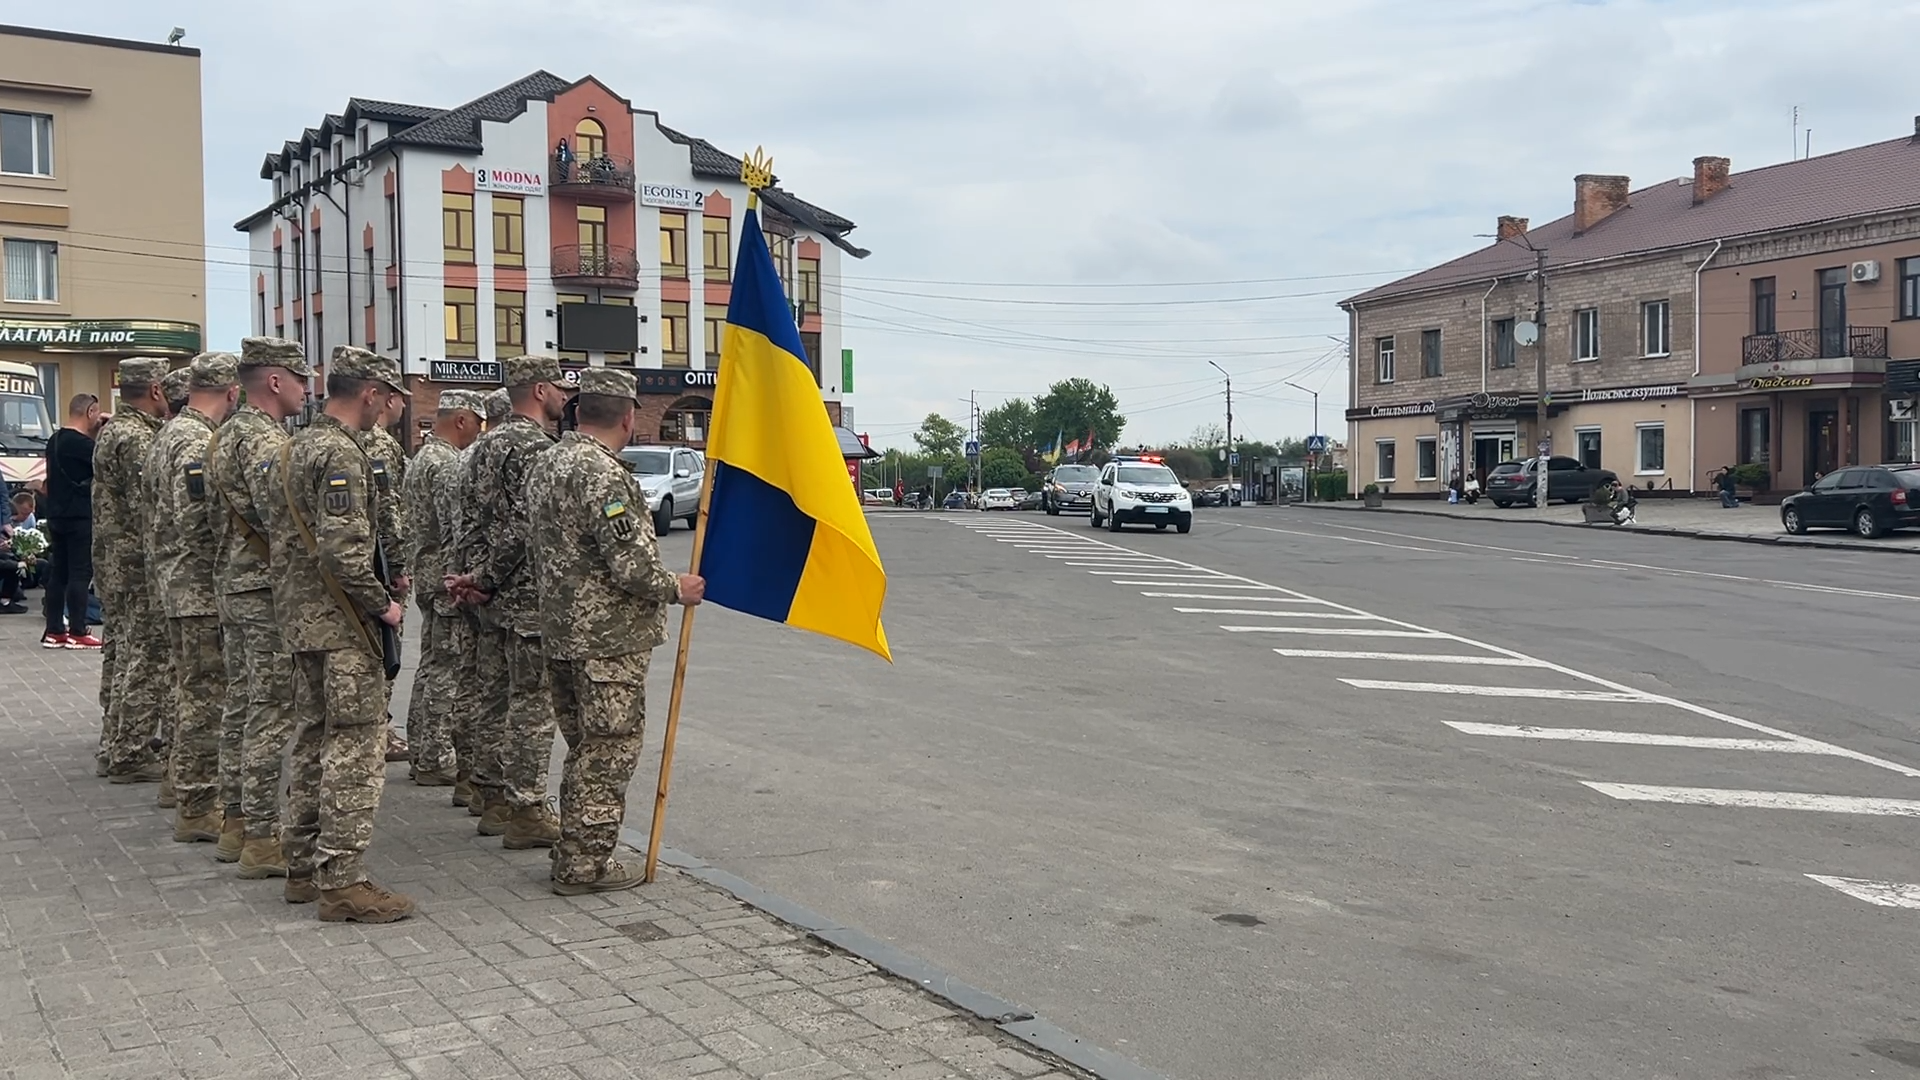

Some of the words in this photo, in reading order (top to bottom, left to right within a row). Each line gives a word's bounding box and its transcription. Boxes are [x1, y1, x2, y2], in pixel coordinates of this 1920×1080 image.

[478, 169, 486, 183] 3
[492, 170, 541, 186] MODNA
[644, 185, 691, 200] EGOIST
[695, 191, 703, 205] 2
[435, 362, 496, 376] MIRACLE
